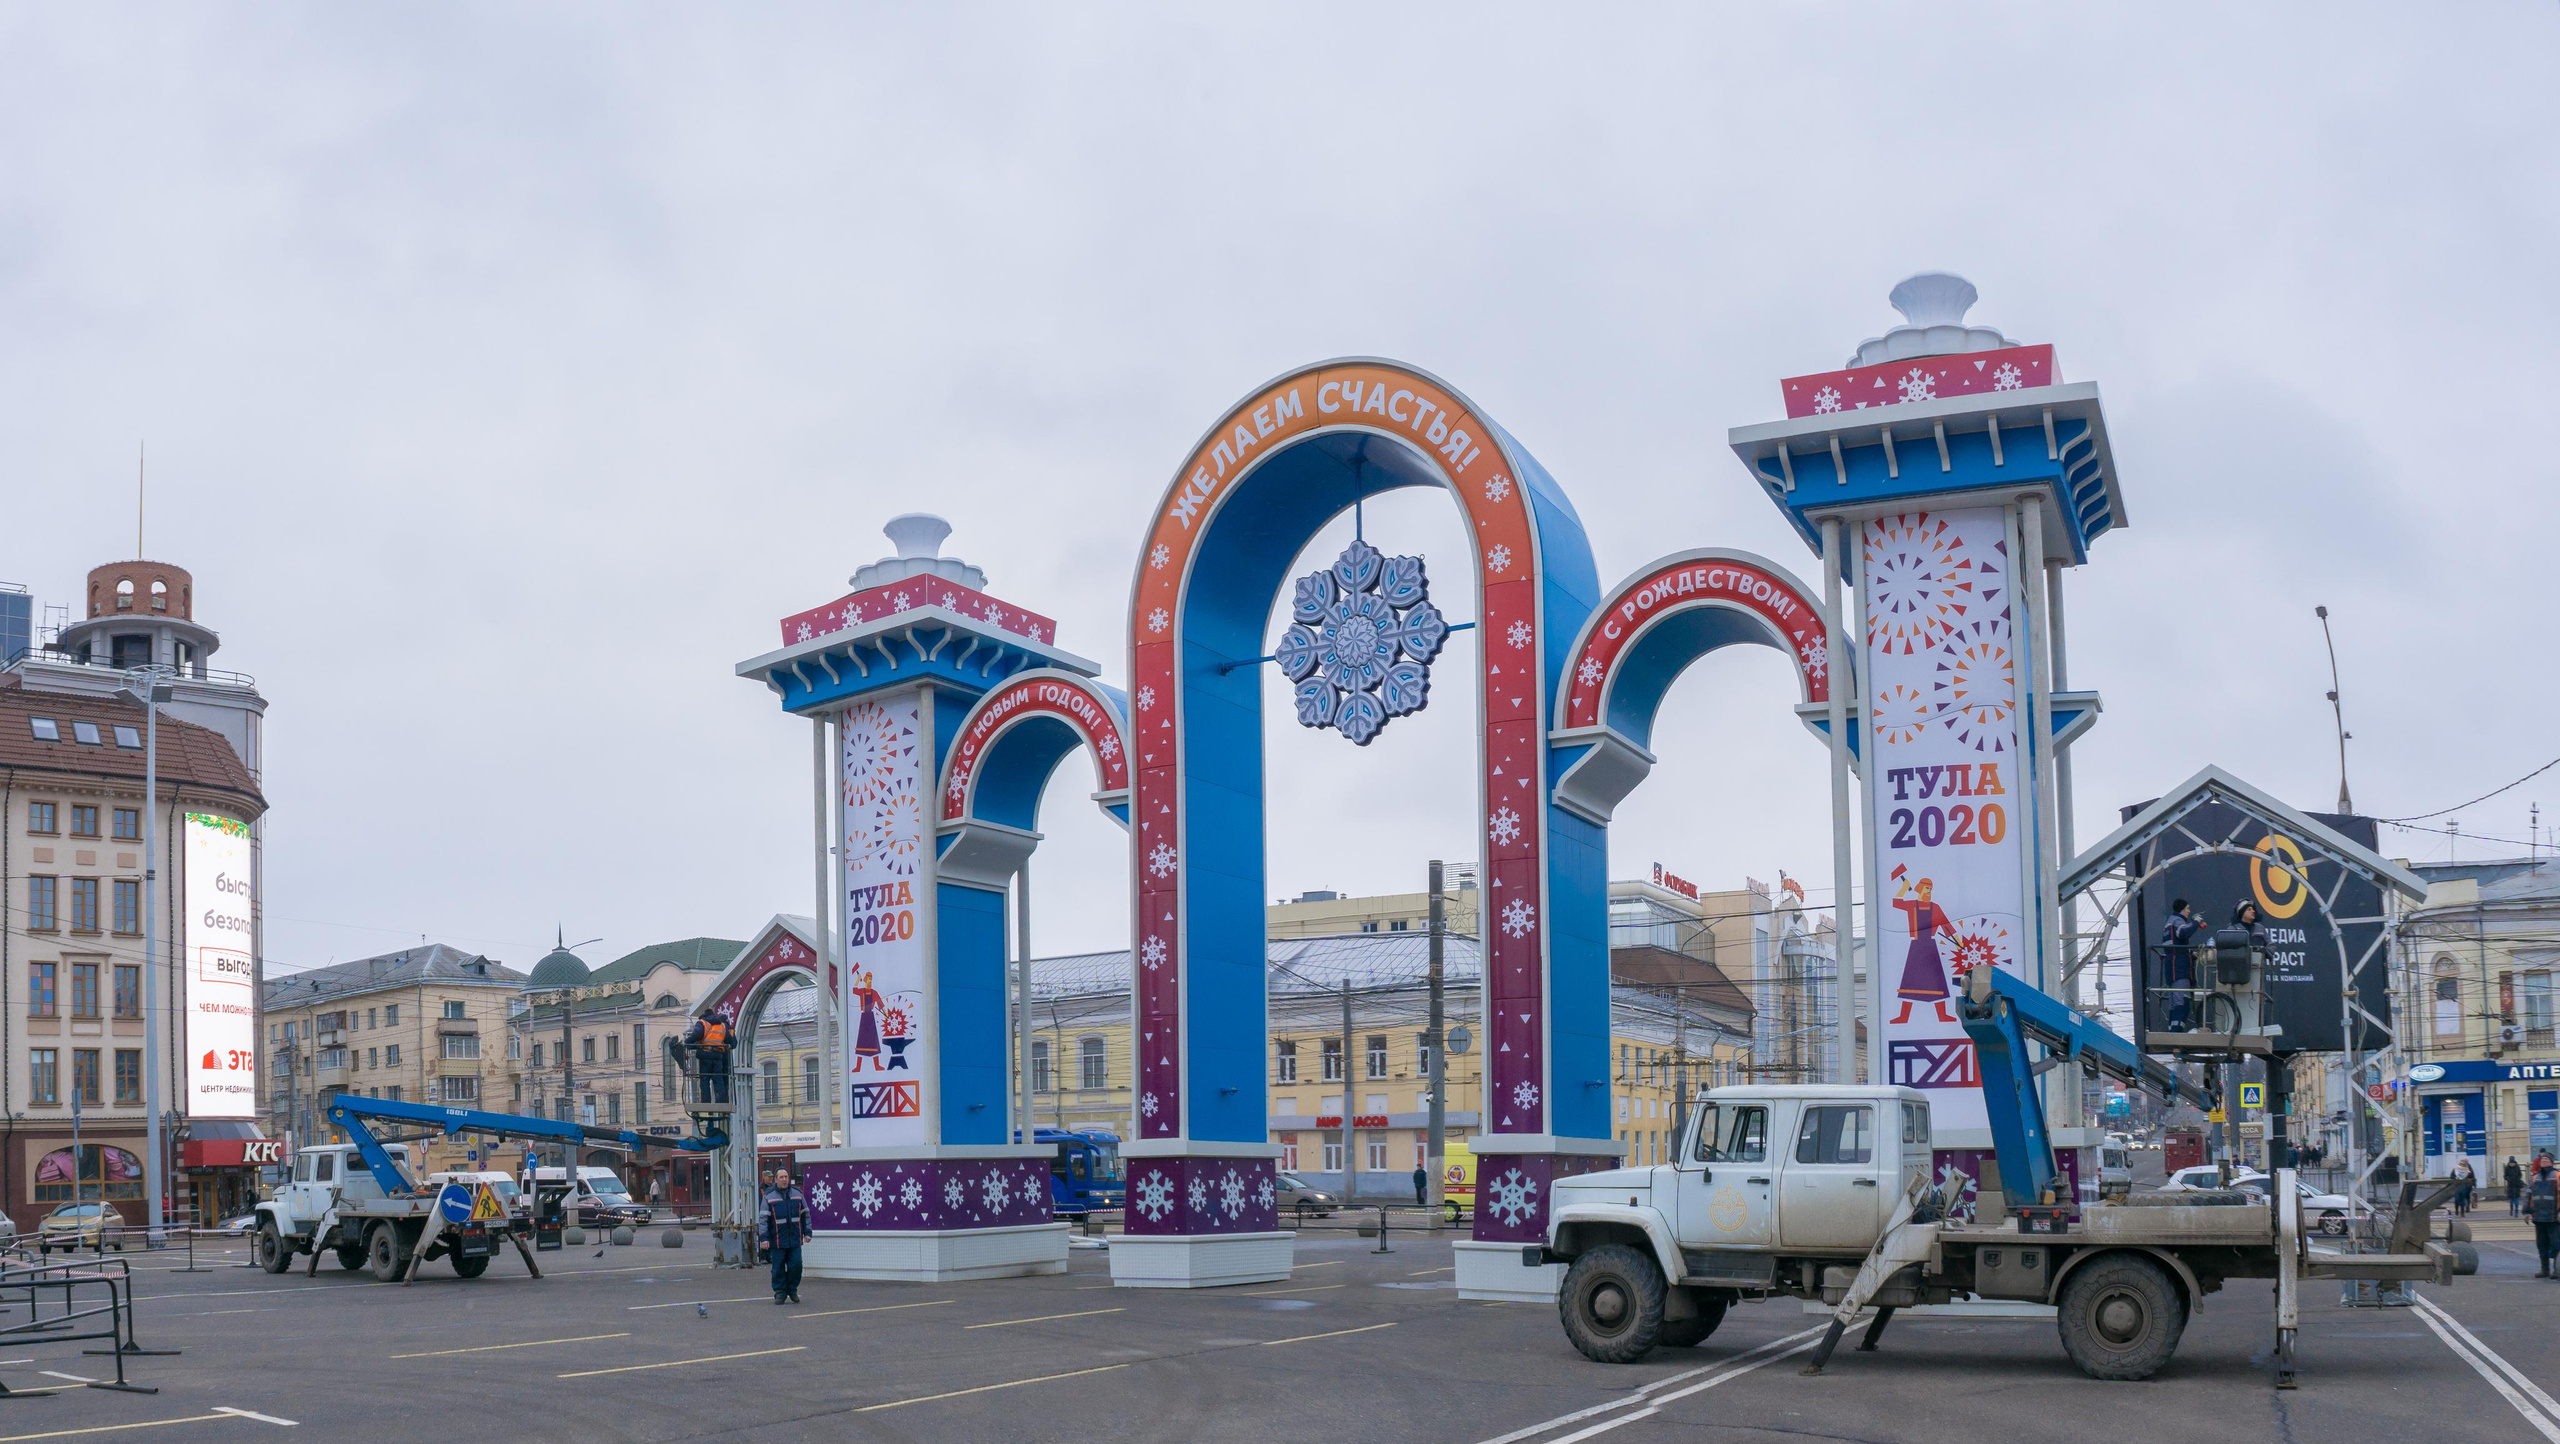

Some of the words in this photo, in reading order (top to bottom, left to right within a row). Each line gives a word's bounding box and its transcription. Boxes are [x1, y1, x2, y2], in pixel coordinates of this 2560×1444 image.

[1170, 388, 1304, 530] ЖЕЛАЕМ
[1317, 380, 1481, 473] СЧАСТЬЯ!
[1603, 620, 1621, 640] С
[1621, 569, 1797, 622] РОЖДЕСТВОМ!
[963, 741, 975, 757] С
[973, 688, 1029, 740] НОВЫМ
[1038, 685, 1102, 730] ГОДОМ!
[1887, 763, 2006, 800] ТУЛА
[1889, 803, 2006, 849] 2020
[850, 880, 914, 913] ТУЛА
[851, 910, 914, 947] 2020
[2265, 928, 2307, 944] ЕДИА
[217, 957, 252, 979] выгод
[199, 1003, 220, 1013] ЧЕМ
[200, 1085, 224, 1094] ЦЕНТР
[650, 1126, 681, 1135] СОГАЗ
[1315, 1116, 1343, 1128] МИР
[243, 1142, 282, 1162] KFC
